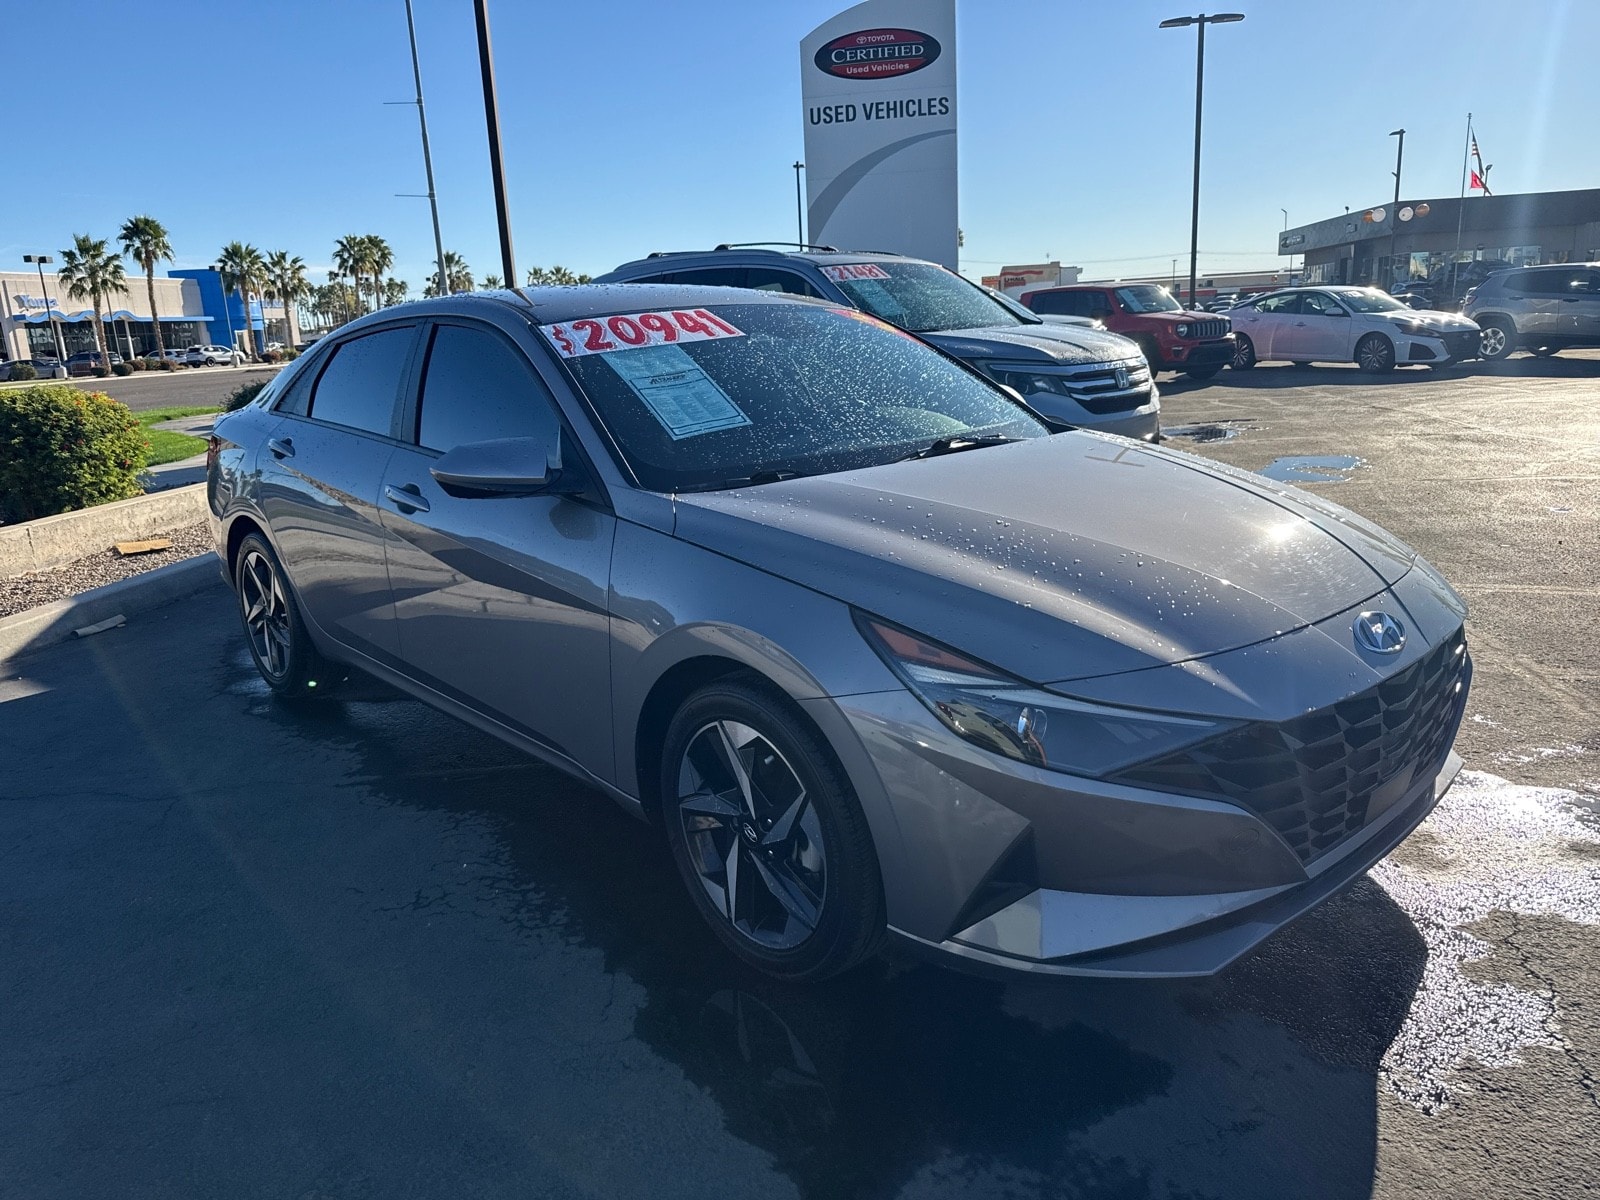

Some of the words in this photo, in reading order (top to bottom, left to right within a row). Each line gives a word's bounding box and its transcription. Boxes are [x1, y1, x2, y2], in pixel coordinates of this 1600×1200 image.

[867, 34, 896, 43] TOYOTA
[831, 44, 925, 64] CERTIFIED
[846, 64, 870, 75] Used
[871, 62, 910, 73] Vehicles
[810, 103, 857, 126] USED
[862, 96, 950, 121] VEHICLES
